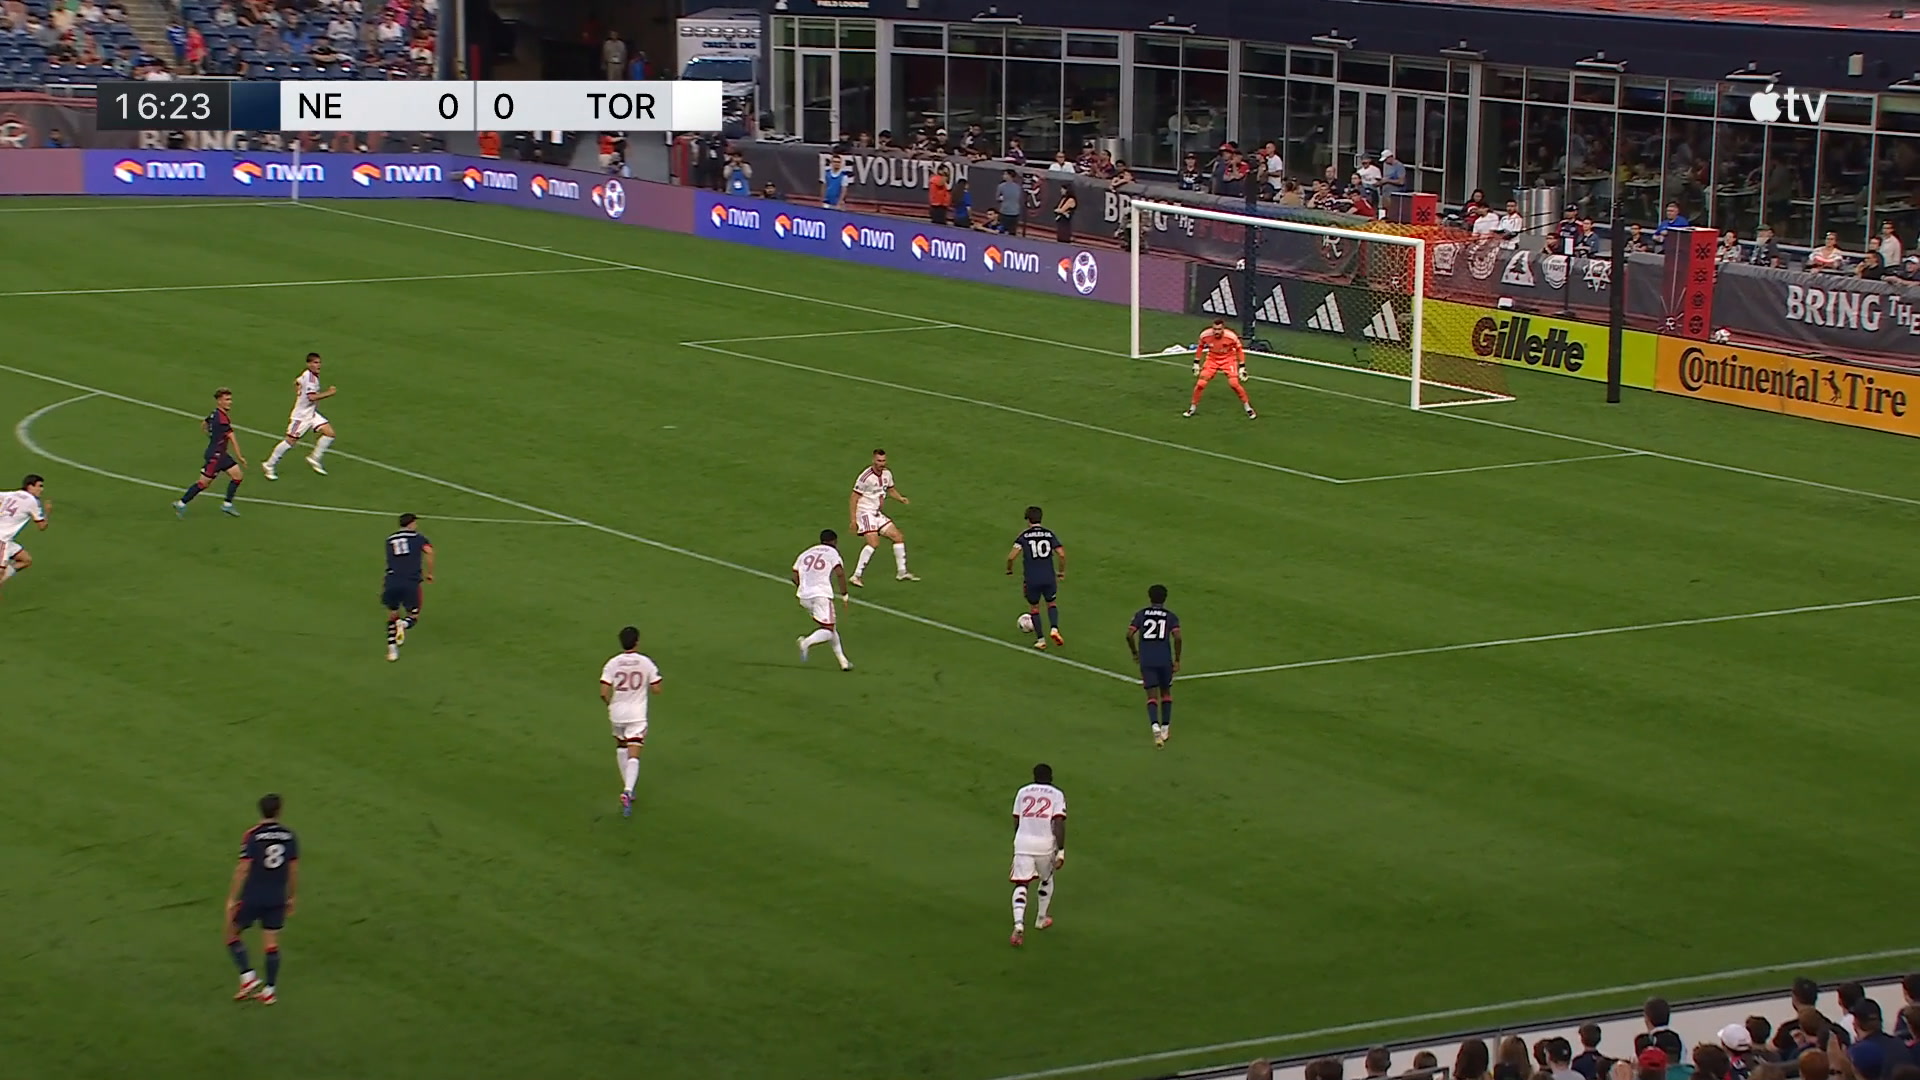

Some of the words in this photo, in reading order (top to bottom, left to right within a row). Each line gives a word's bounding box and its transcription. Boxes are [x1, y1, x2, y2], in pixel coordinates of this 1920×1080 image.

[146, 160, 206, 181] nwn
[265, 161, 325, 182] nwn
[384, 163, 442, 183] nwn
[483, 170, 518, 191] nwn
[548, 179, 580, 200] nwn
[727, 207, 760, 229] nwn
[792, 217, 826, 240] nwn
[860, 228, 895, 251] nwn
[930, 239, 967, 262] nwn
[1003, 249, 1040, 273] nwn
[1786, 285, 1881, 331] BRING
[1888, 296, 1920, 335] THE
[1472, 316, 1585, 372] Gillette
[1679, 347, 1820, 403] Continental
[1842, 372, 1907, 417] Tire
[390, 538, 410, 555] 11
[1028, 540, 1051, 558] 10
[803, 553, 826, 572] 96
[1143, 619, 1166, 639] 21
[614, 671, 643, 691] 20
[1022, 796, 1052, 818] 22
[263, 843, 286, 869] 8
